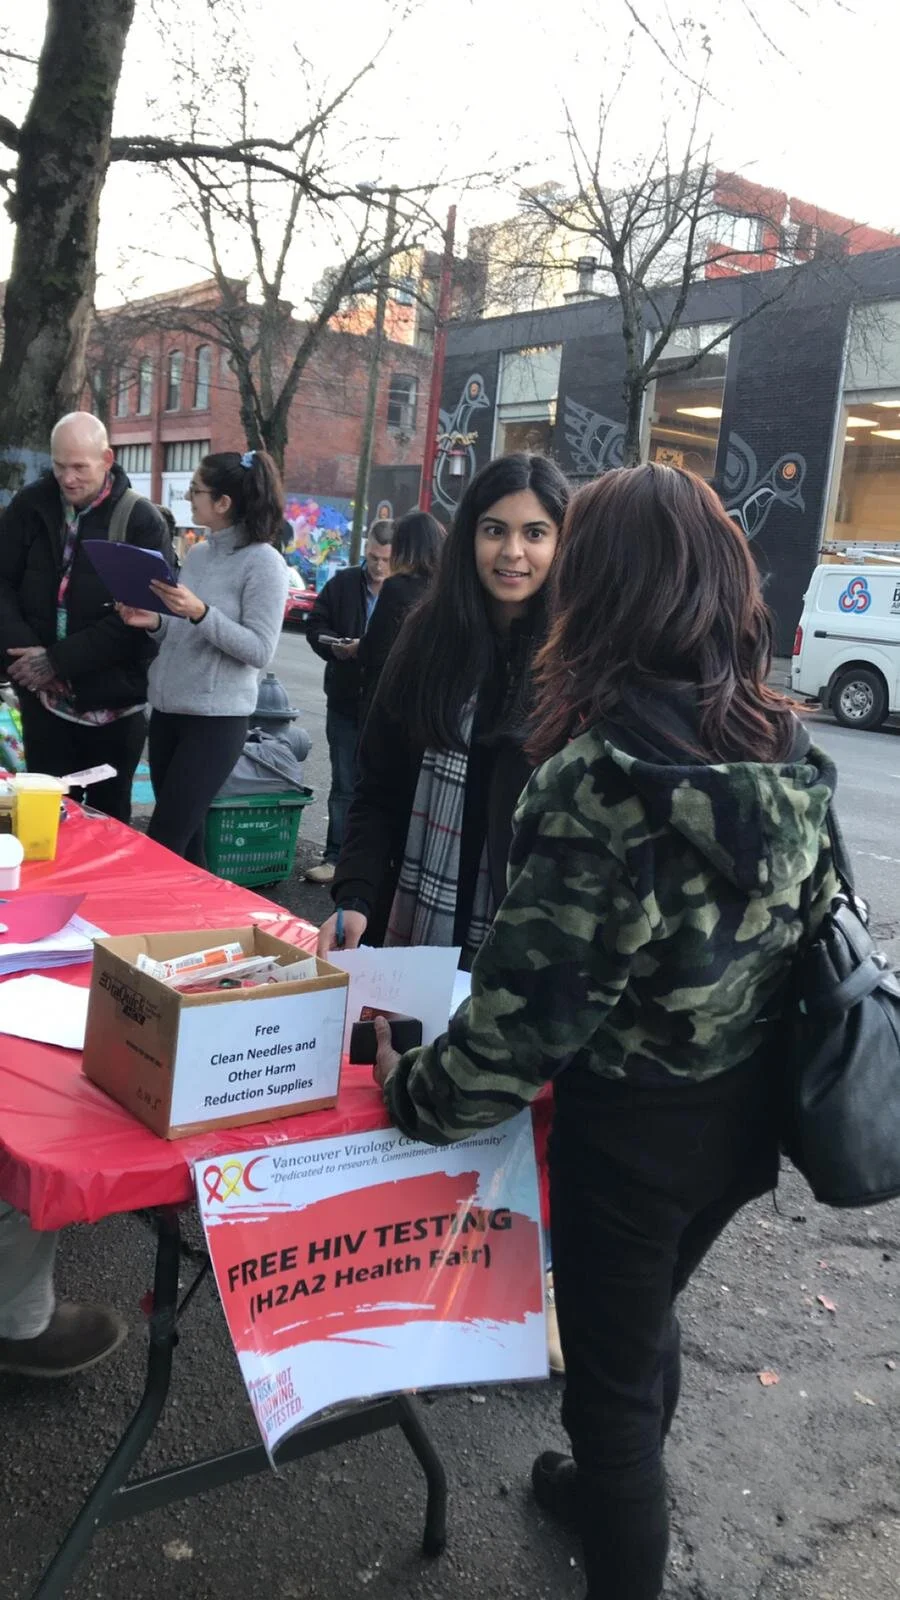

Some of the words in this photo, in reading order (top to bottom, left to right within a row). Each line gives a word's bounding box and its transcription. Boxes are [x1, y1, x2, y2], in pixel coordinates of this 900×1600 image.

[255, 1024, 280, 1036] Free
[210, 1053, 244, 1066] Clean
[247, 1044, 293, 1060] Needles
[295, 1038, 317, 1052] and
[228, 1069, 262, 1083] Other
[265, 1063, 296, 1076] Harm
[204, 1088, 264, 1107] Reduction
[267, 1078, 313, 1095] Supplies
[272, 1149, 342, 1169] Vancouver
[344, 1137, 396, 1157] Virology
[325, 1164, 336, 1174] to
[381, 1146, 438, 1163] Commitment
[227, 1246, 298, 1293] FREE
[308, 1230, 367, 1264] HIV
[374, 1207, 513, 1248] TESTING
[250, 1274, 326, 1323] (H2A2
[334, 1254, 421, 1288] Health
[429, 1244, 491, 1269] Fair)
